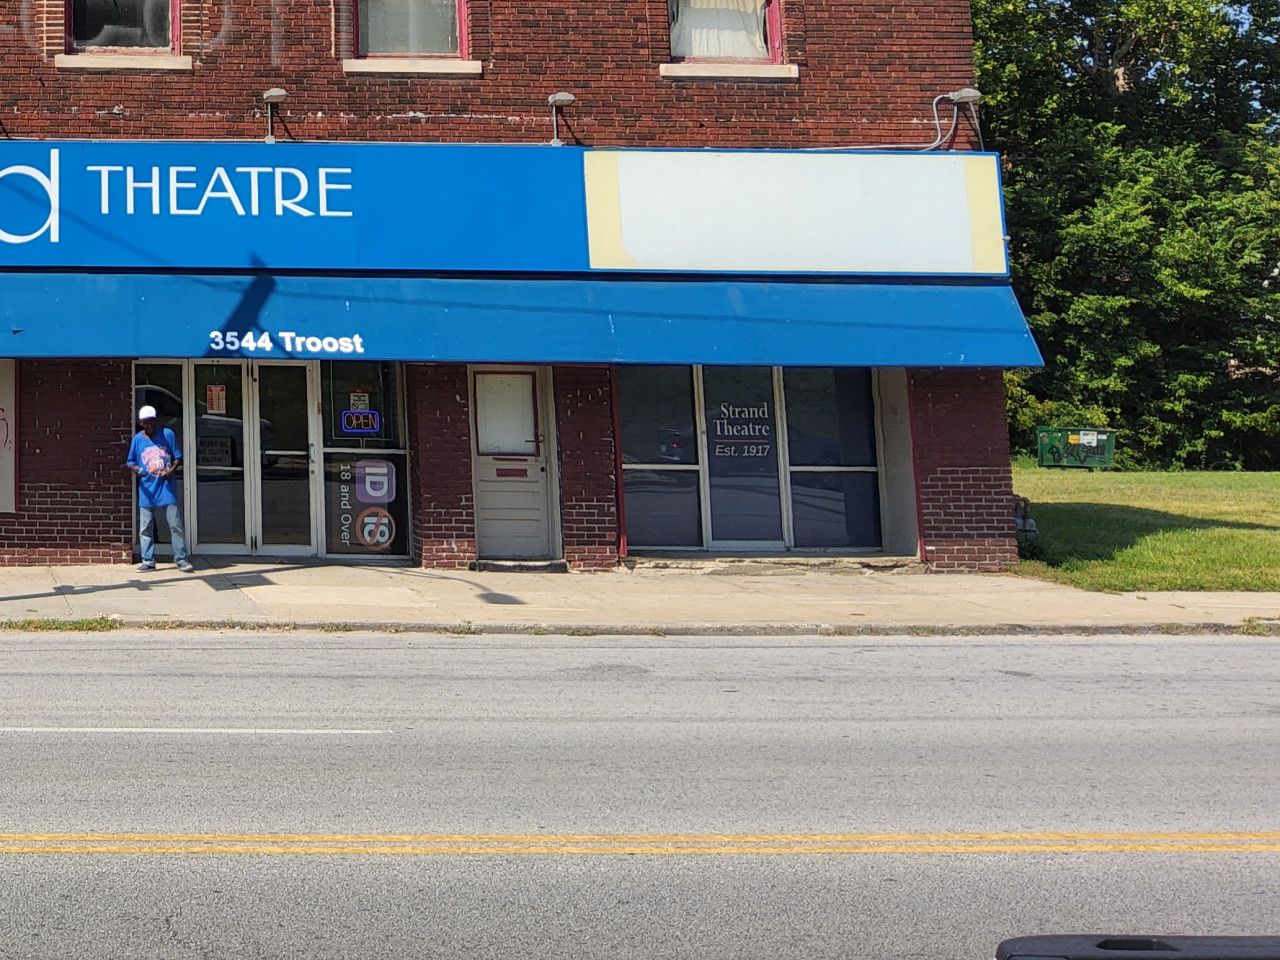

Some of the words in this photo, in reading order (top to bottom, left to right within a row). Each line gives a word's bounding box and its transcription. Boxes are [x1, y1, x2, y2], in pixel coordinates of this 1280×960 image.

[86, 166, 353, 216] THEATRE
[209, 331, 273, 351] 3544
[278, 331, 365, 353] Troost
[720, 402, 769, 419] Strand
[344, 413, 377, 429] OPEN
[713, 419, 770, 436] Theatre
[715, 445, 738, 456] Est.
[742, 445, 770, 456] 1917
[340, 463, 352, 480] 18
[365, 466, 388, 497] ID
[340, 485, 352, 509] and
[340, 514, 352, 546] Over
